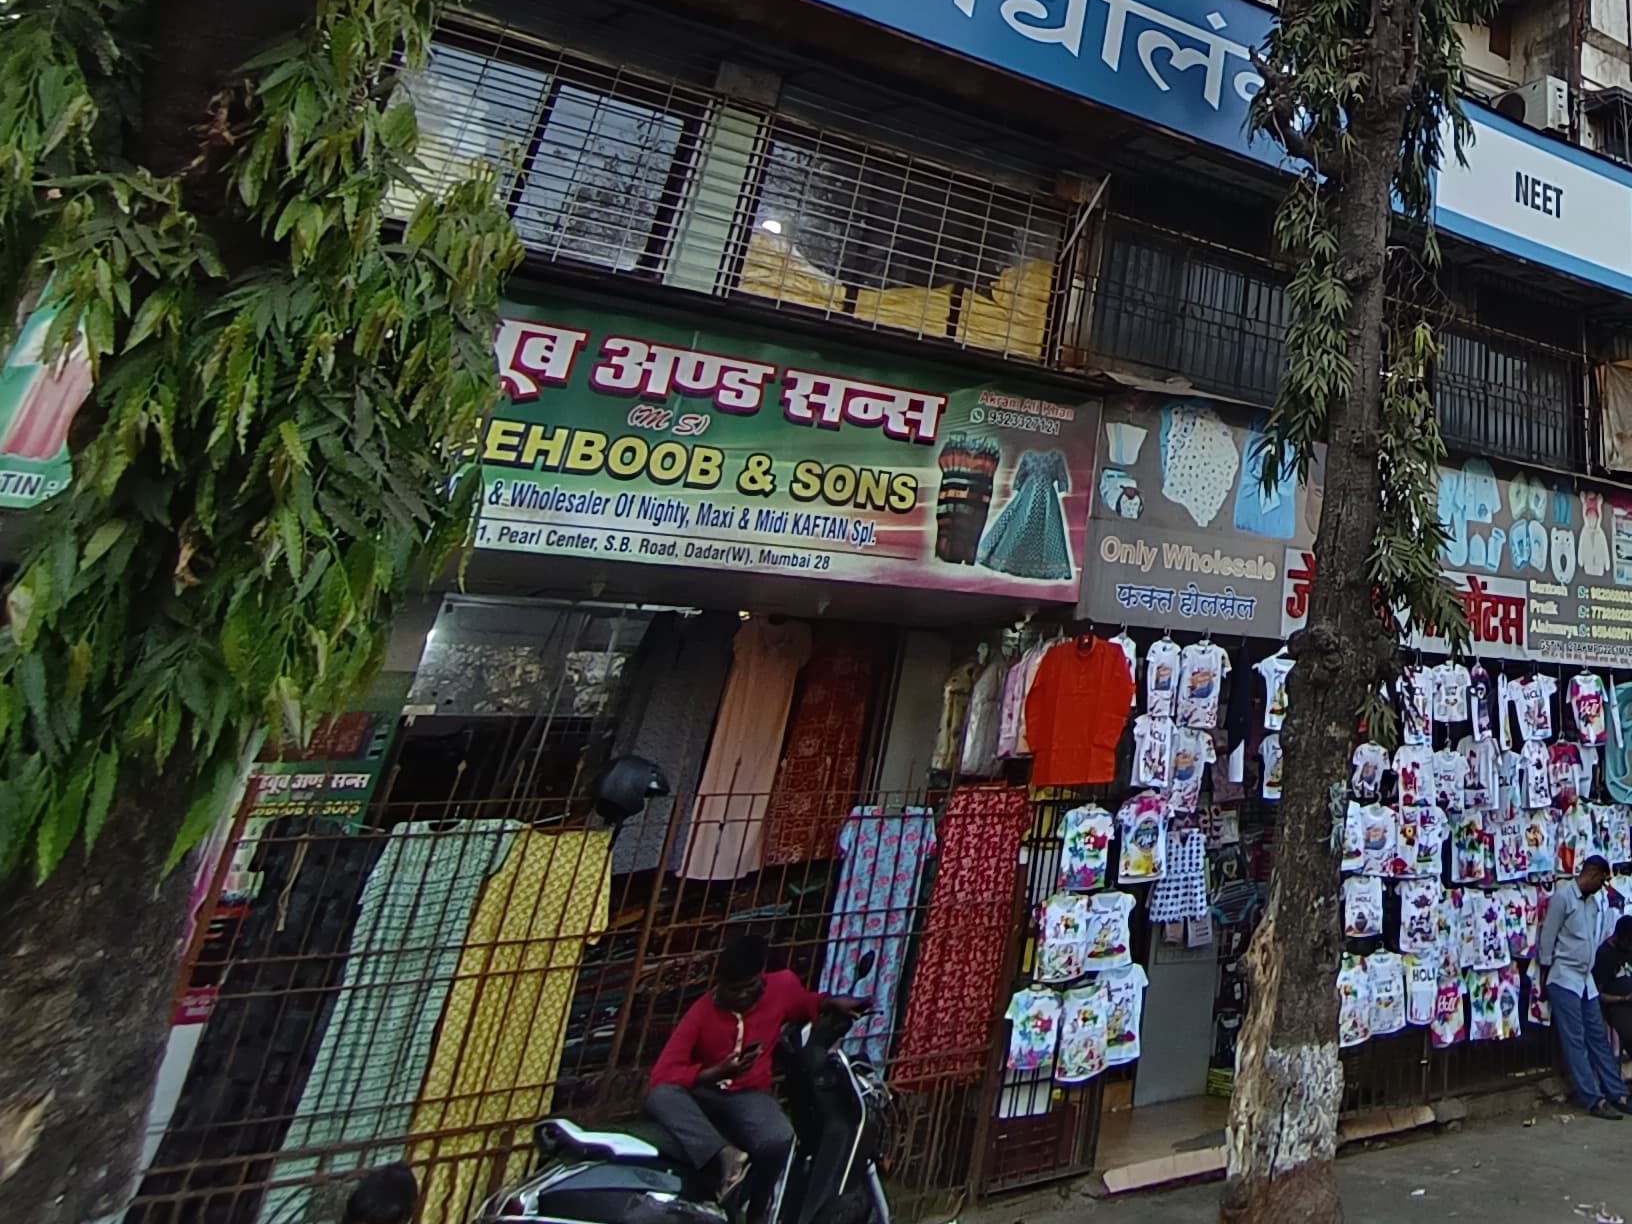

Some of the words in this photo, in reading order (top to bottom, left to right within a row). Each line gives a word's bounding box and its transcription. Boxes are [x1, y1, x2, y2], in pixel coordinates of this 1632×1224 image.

[1515, 171, 1563, 219] NEET
[590, 335, 777, 415] अण्ड
[782, 367, 948, 444] सन्स
[979, 391, 1020, 411] Akram
[1021, 398, 1041, 414] Ali
[1042, 401, 1075, 421] Khan
[736, 452, 777, 498] &
[789, 459, 919, 514] SONS
[488, 480, 504, 506] &
[511, 481, 610, 515] Wholesaler
[614, 491, 636, 518] Of
[636, 494, 690, 529] Nighty,
[696, 502, 735, 529] Maxi
[738, 507, 750, 530] &
[754, 509, 789, 534] Midi
[790, 513, 849, 541] KAFTAN
[851, 520, 877, 547] Spl.
[497, 526, 542, 546] Pearl
[545, 531, 598, 552] Center,
[603, 535, 633, 553] S.B.
[638, 538, 679, 559] Road,
[758, 548, 811, 569] Mumbai
[813, 554, 831, 570] 28
[1100, 535, 1157, 572] Only
[1162, 543, 1277, 582] Wholesale
[1115, 583, 1175, 614] फक्त
[1179, 584, 1258, 621] होलसेल
